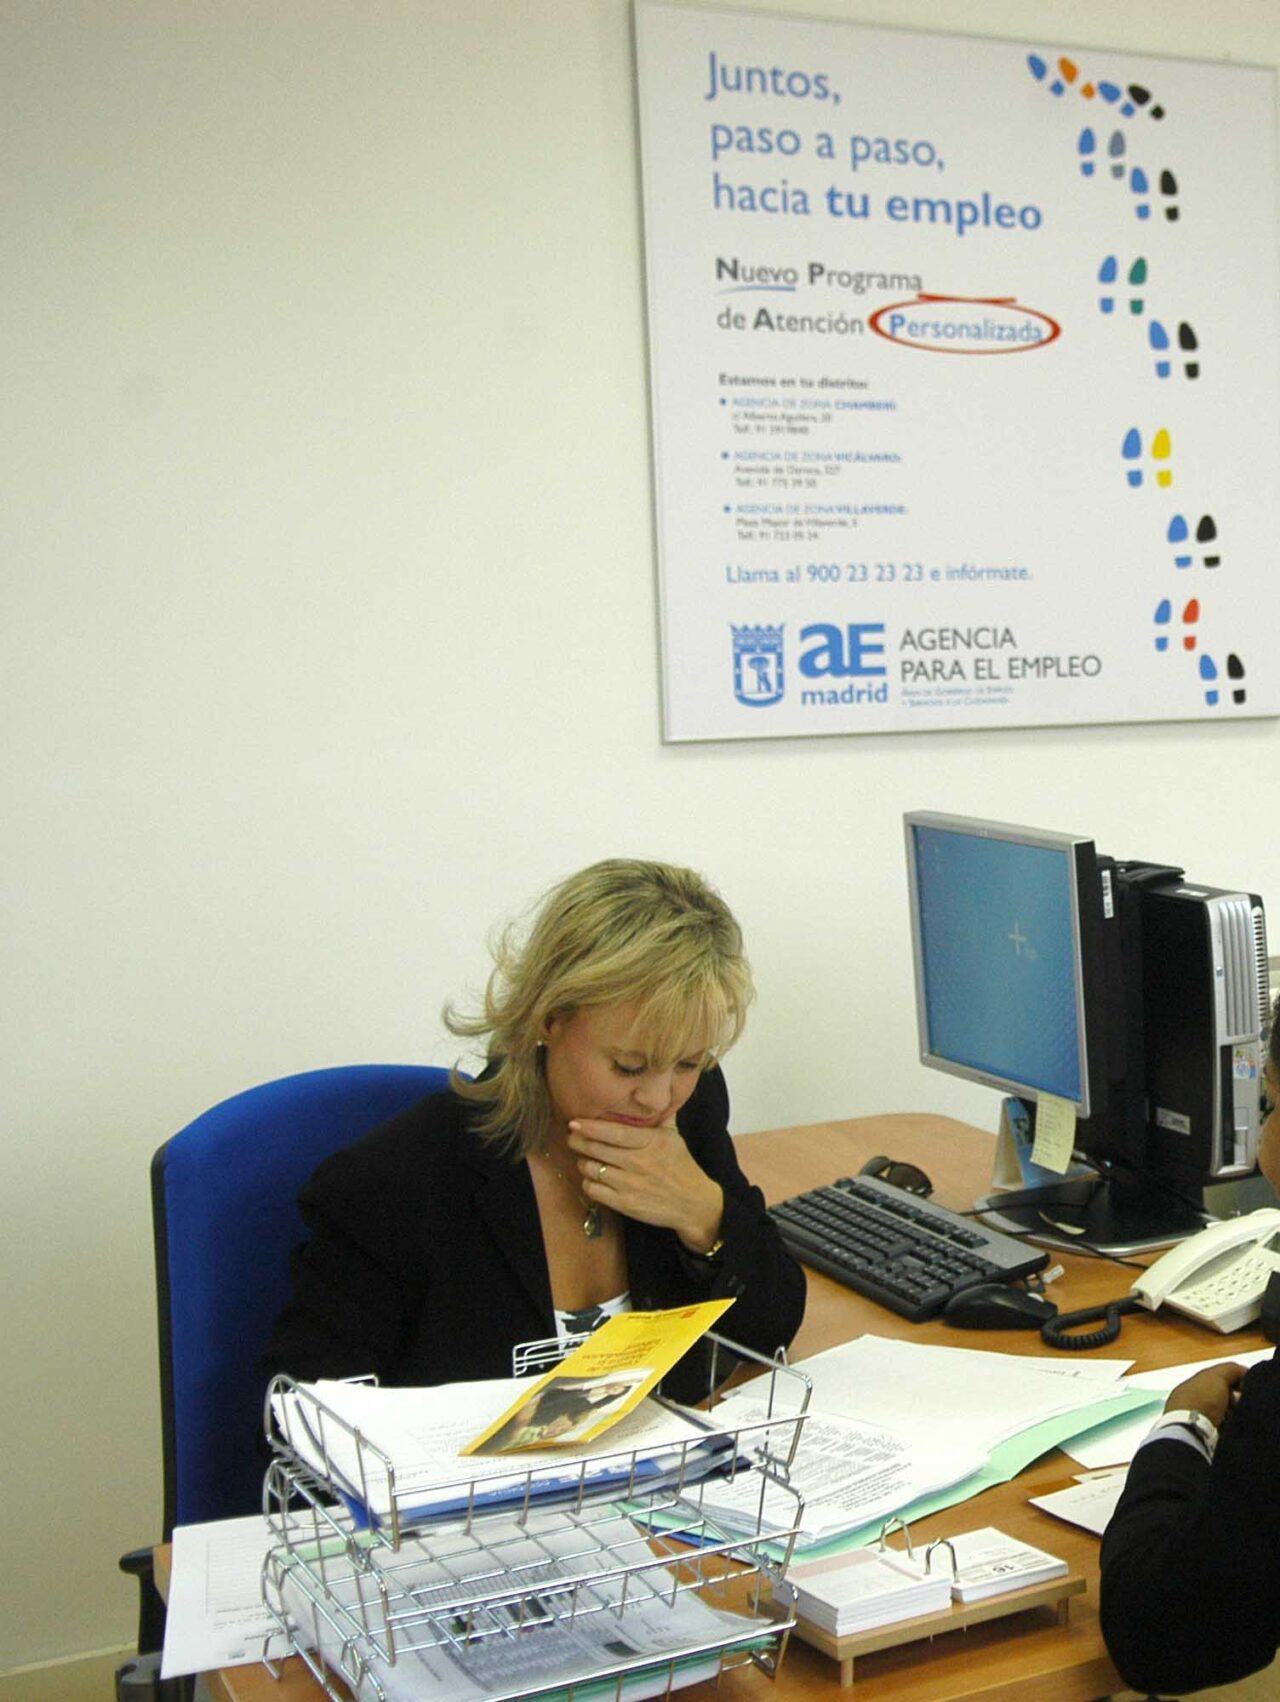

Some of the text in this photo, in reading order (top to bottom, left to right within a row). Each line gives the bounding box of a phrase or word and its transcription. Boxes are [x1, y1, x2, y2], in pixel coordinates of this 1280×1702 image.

[704, 51, 841, 105] Juntos,
[711, 123, 945, 172] paso a paso,
[713, 172, 1042, 236] hacia tu empleo
[715, 258, 923, 294] Nuevo Programa
[717, 307, 864, 336] de Atención
[889, 313, 1044, 343] Personalizada
[718, 373, 776, 387] Estamos
[779, 378, 796, 388] en
[799, 378, 815, 389] tu
[726, 562, 1033, 583] Llama al 900 23 23 23 e infórmate.
[900, 627, 1017, 651] AGENCIA
[901, 655, 1102, 682] PARA EL EMPLEO
[801, 682, 888, 706] madrid
